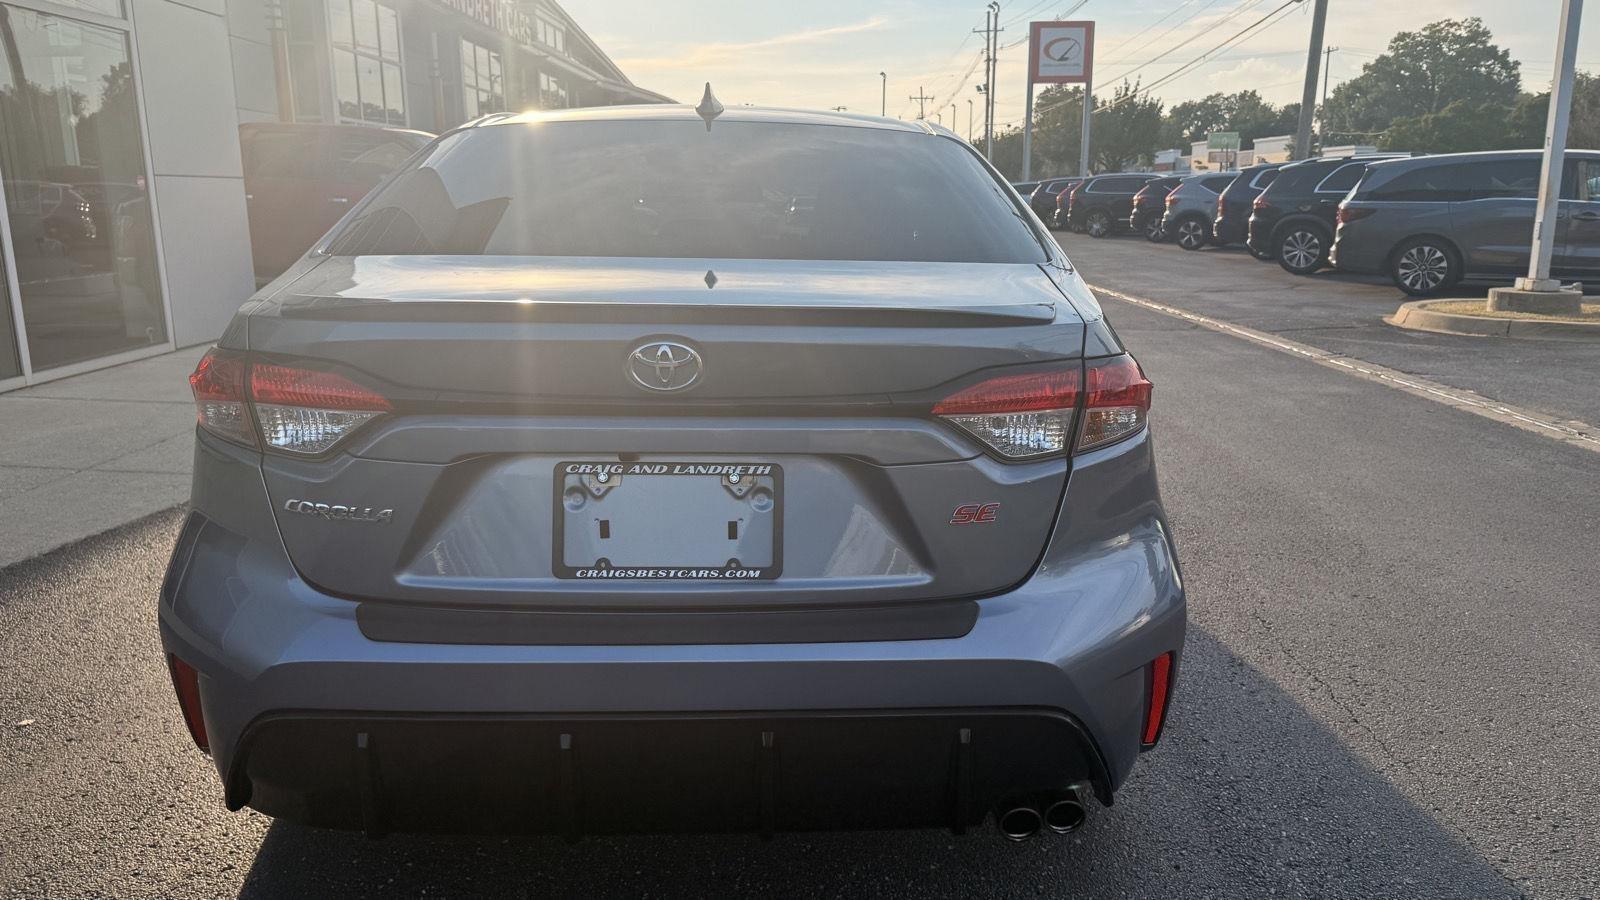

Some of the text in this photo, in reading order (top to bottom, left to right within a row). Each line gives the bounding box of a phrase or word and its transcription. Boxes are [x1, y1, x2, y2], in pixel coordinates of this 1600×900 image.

[565, 464, 771, 475] CRAIG AND LANDRETH
[284, 499, 393, 522] COROLLA
[950, 502, 1001, 524] SE
[575, 569, 761, 578] CRAIGSBESTCARS.COM
